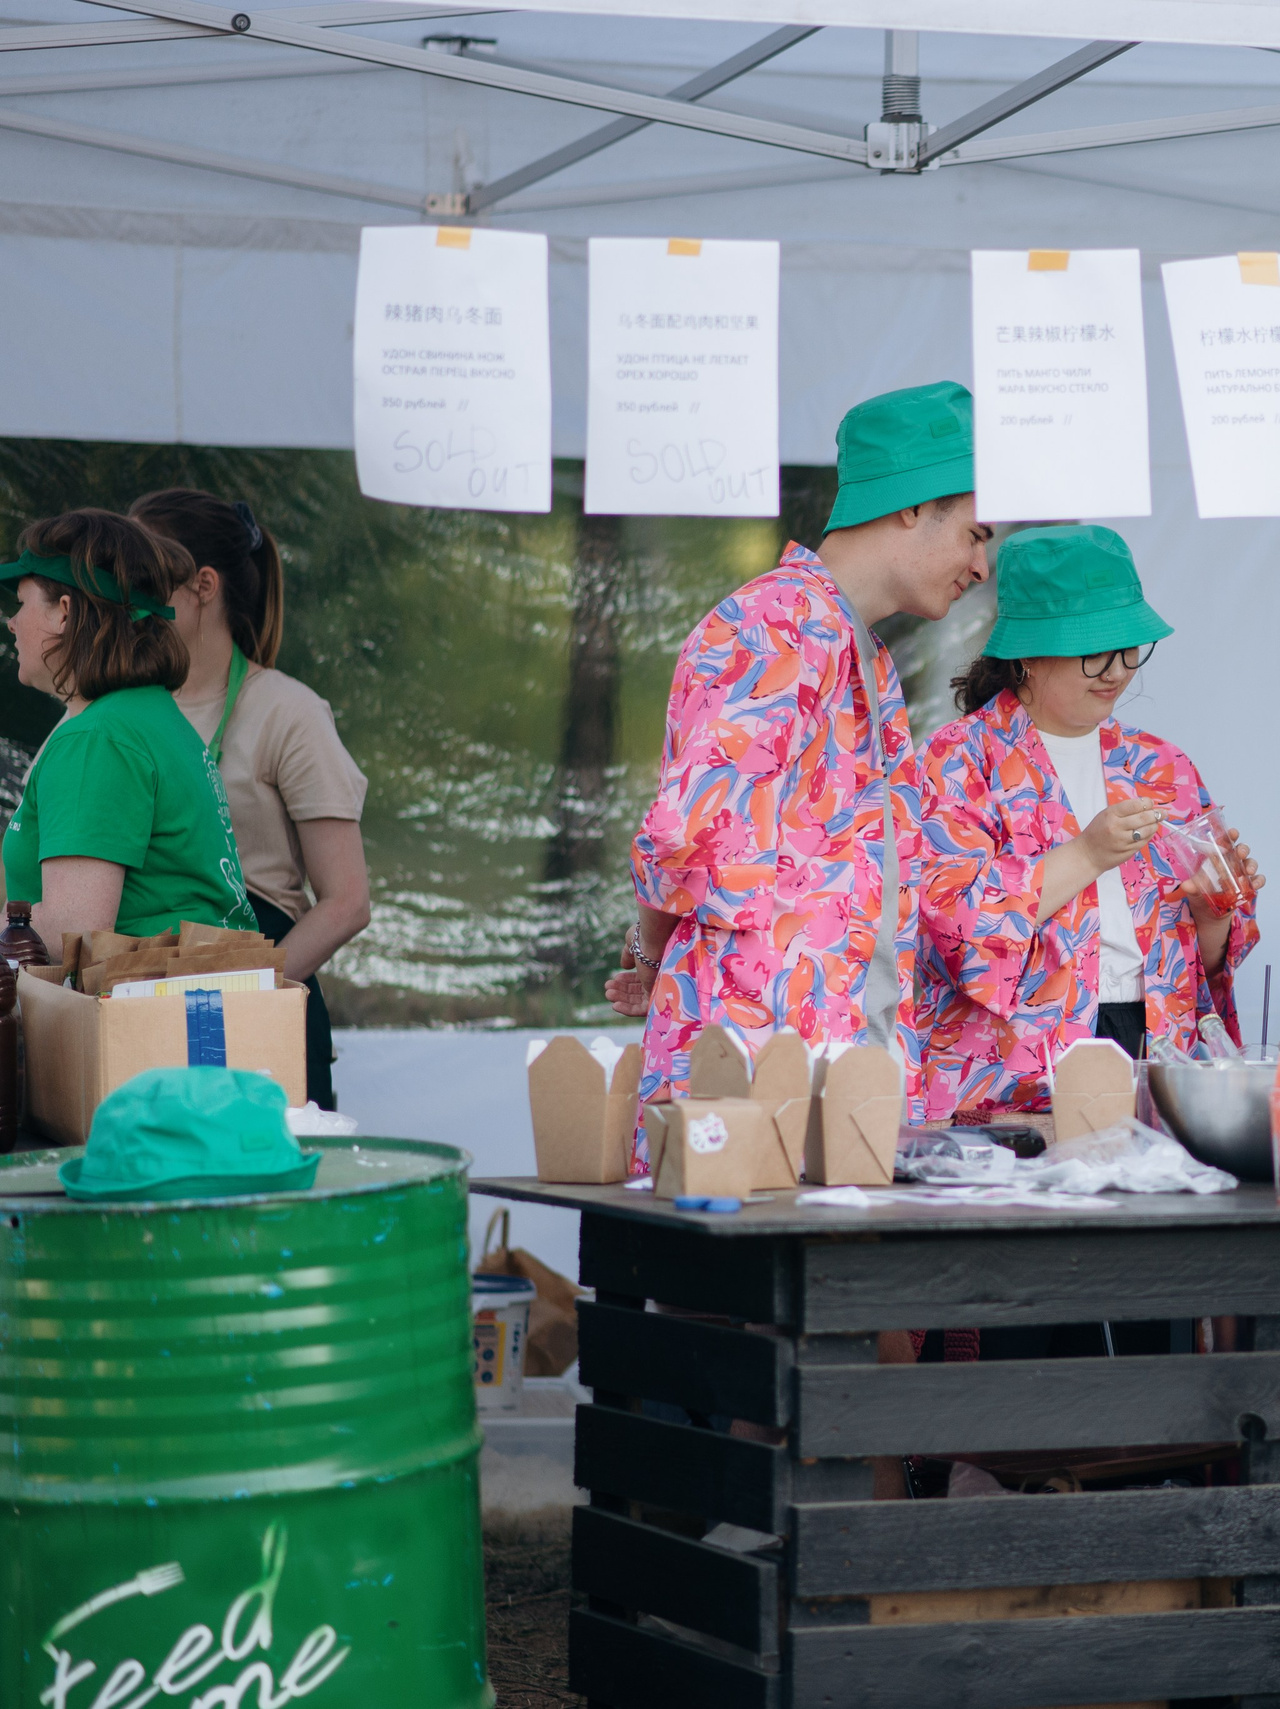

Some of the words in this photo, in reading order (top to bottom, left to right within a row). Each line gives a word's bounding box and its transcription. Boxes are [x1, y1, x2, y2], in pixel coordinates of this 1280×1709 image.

[995, 323, 1117, 344] 芒果辣椒柠檬水
[382, 349, 416, 360] УДОН
[418, 350, 474, 361] СВИНИНА
[477, 351, 505, 362] НОЖ
[617, 353, 650, 365] УДОН
[651, 353, 690, 366] ПТИЦА
[692, 354, 707, 366] НЕ
[709, 354, 749, 366] ЛЕТАЕТ
[382, 365, 427, 377] ОСТРАЯ
[430, 366, 467, 378] ПЕРЕЦ
[470, 367, 516, 380] ВКУСНО
[616, 369, 646, 381] ОРЕХ
[648, 370, 699, 381] ХОРОШО
[996, 368, 1023, 379] ПИТЬ
[1024, 368, 1061, 379] МАНГО
[1061, 367, 1092, 378] ЧИЛИ
[1204, 369, 1232, 380] ПИТЬ
[998, 384, 1026, 394] ЖАРА
[1028, 383, 1067, 394] ВКУСНО
[1068, 382, 1109, 394] СТЕКЛО
[1206, 383, 1272, 394] НАТУРАЛЬНО
[382, 396, 403, 408] 350
[404, 397, 447, 410] рублей
[616, 401, 637, 413] 350
[638, 401, 679, 414] рублей
[999, 415, 1018, 426] 200
[1019, 415, 1055, 427] рублей
[1211, 415, 1229, 425] 200
[1231, 414, 1266, 426] рублей
[392, 422, 498, 474] SOLD
[626, 437, 728, 485] SOLD
[708, 466, 771, 505] OUT
